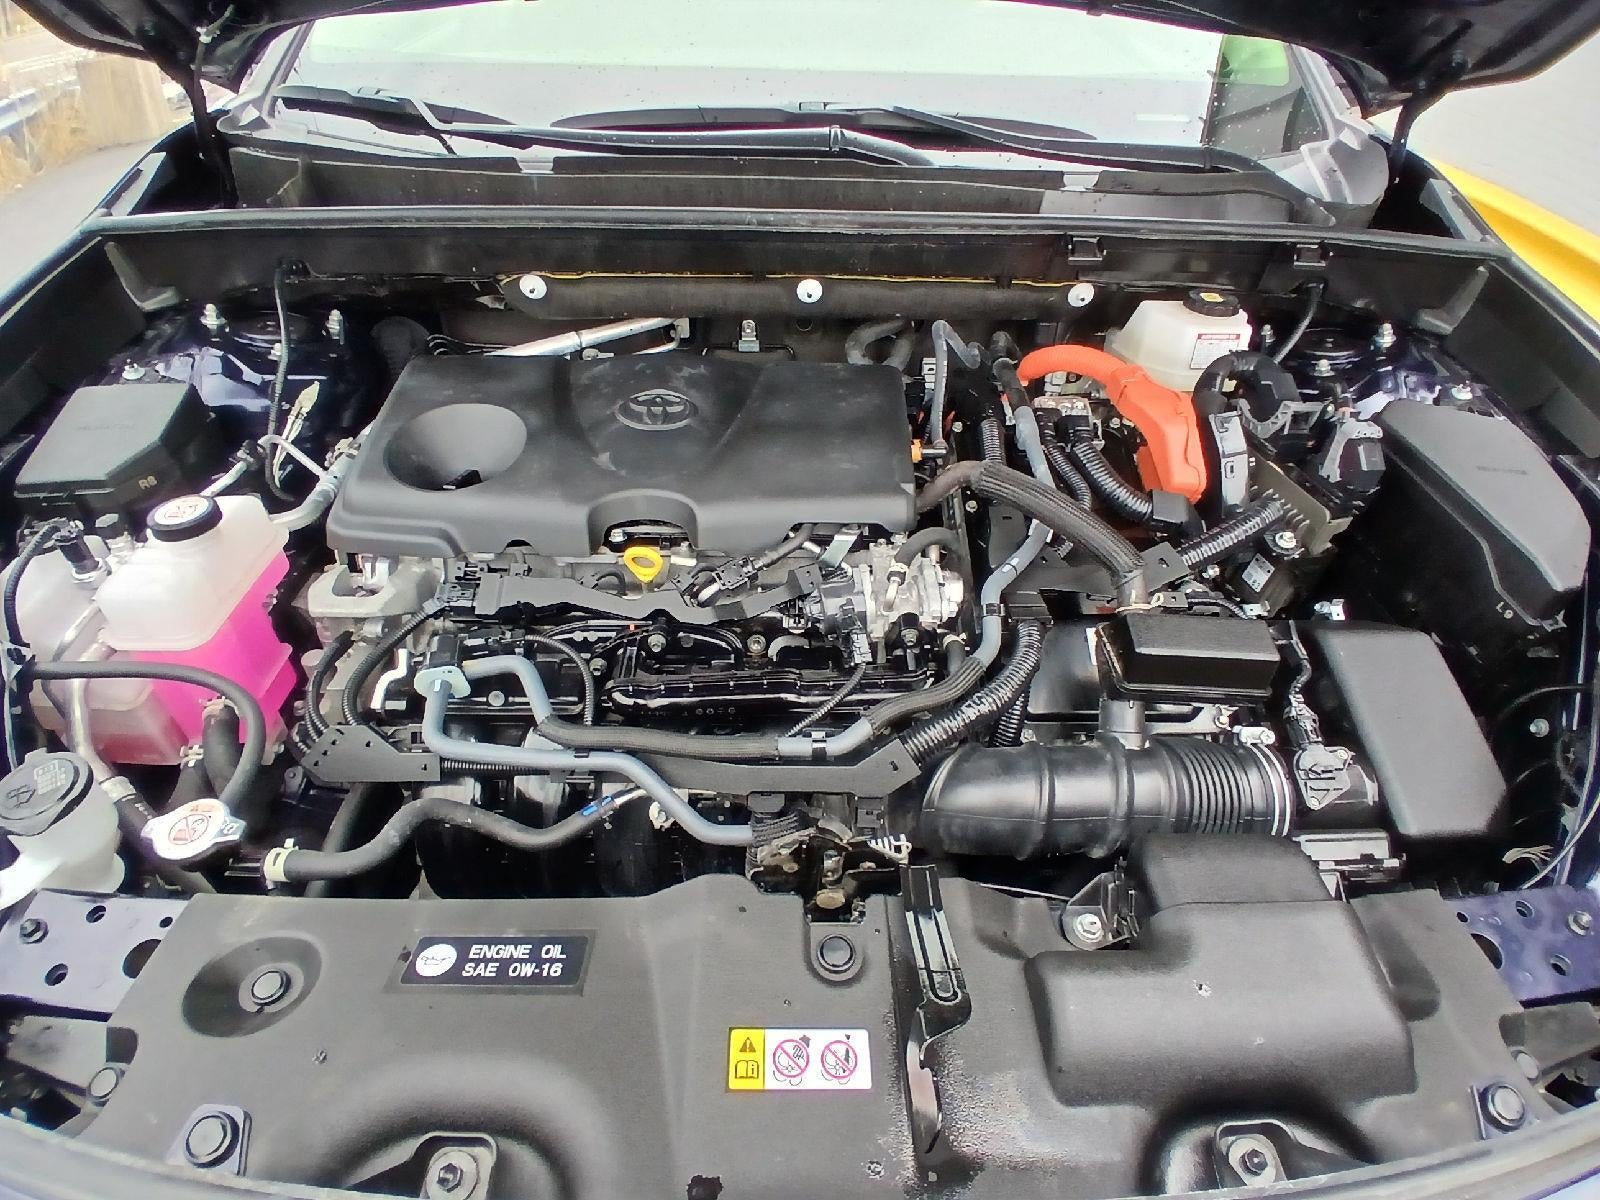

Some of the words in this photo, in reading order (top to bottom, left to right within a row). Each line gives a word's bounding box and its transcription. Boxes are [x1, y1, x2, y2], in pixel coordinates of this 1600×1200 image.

[468, 944, 532, 959] ENGINE
[541, 944, 567, 959] OIL
[461, 962, 500, 977] SAE
[508, 962, 563, 977] 0W-16
